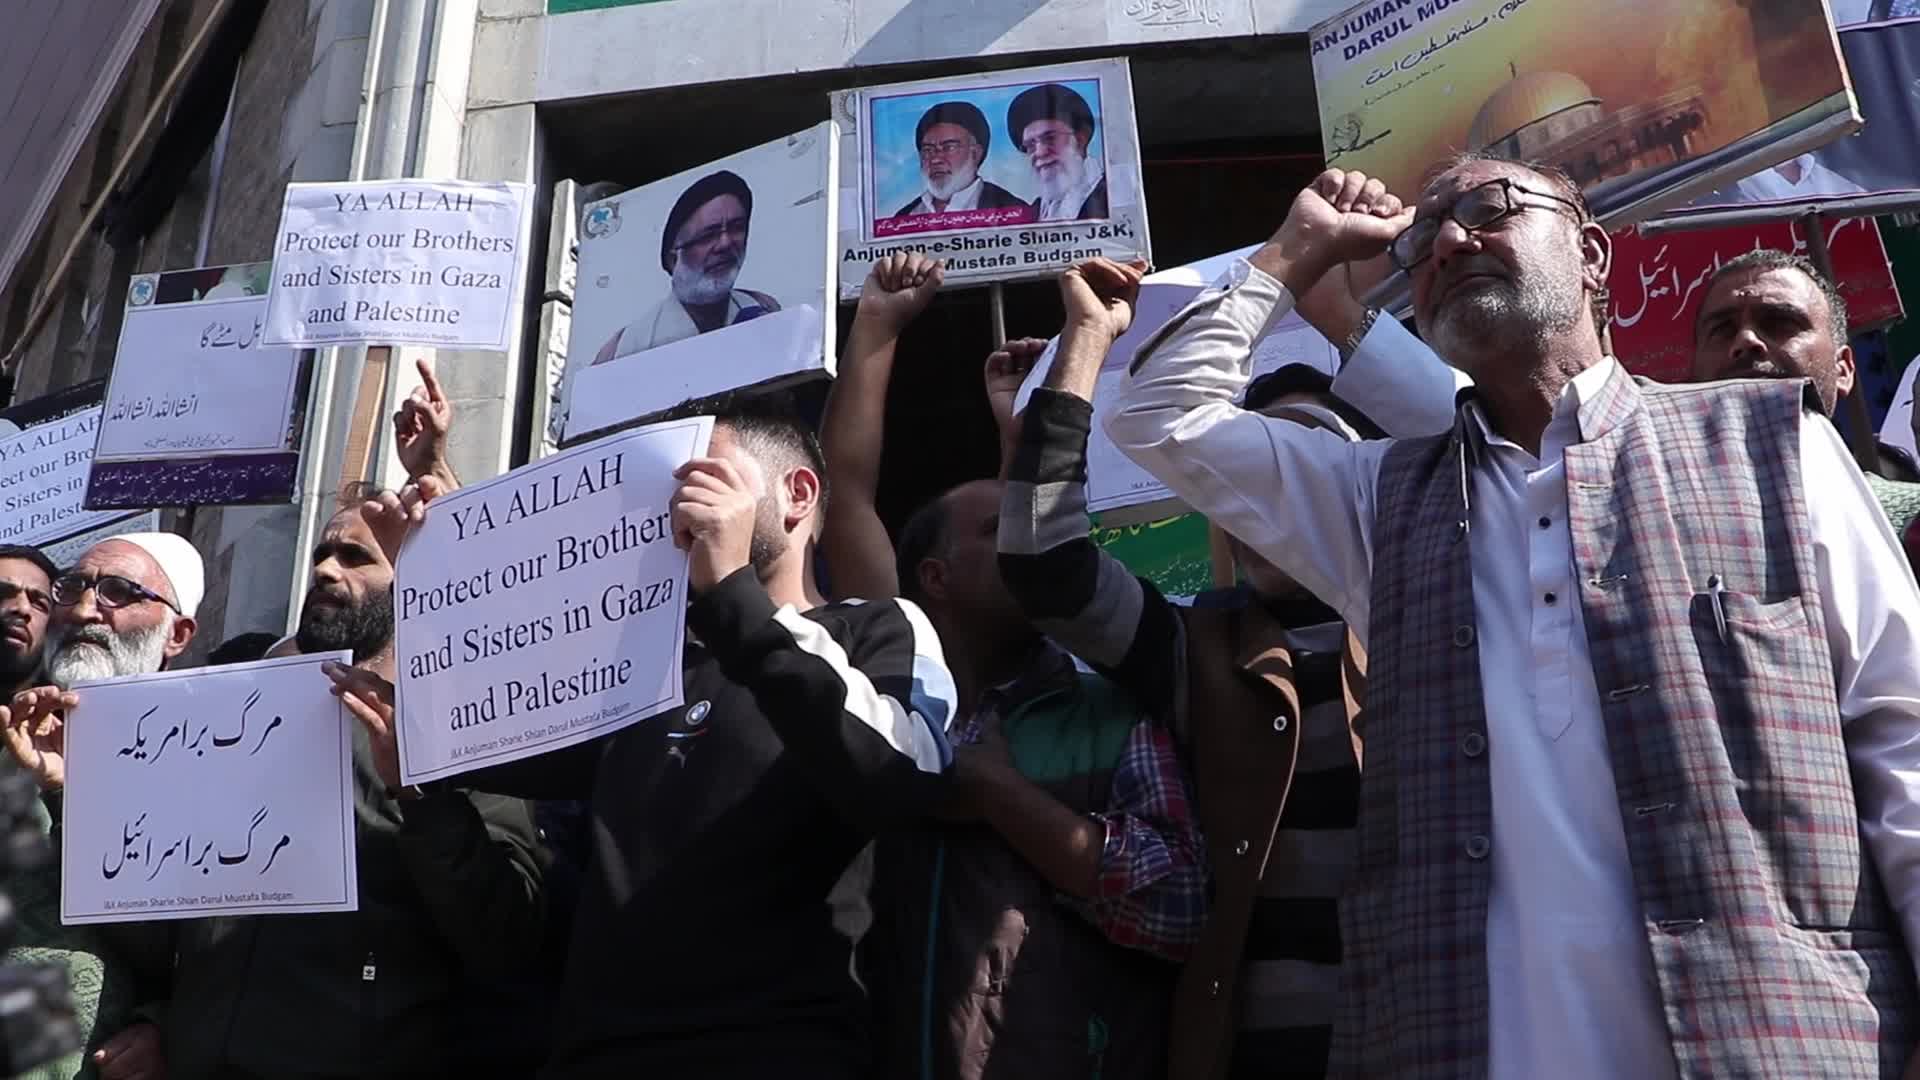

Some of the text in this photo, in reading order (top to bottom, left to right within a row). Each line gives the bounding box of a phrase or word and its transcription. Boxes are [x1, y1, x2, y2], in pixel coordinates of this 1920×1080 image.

[1343, 17, 1413, 61] DARUL
[334, 192, 473, 212] YA ALLAH
[284, 228, 513, 253] Protect our Brothers
[843, 233, 1012, 262] Anjuman-e-Sharie
[1086, 223, 1134, 240] J&K,
[1024, 246, 1103, 264] Budgam
[281, 264, 501, 288] and Sisters in Gaza
[308, 301, 460, 325] and Palestine
[0, 439, 25, 462] YA
[30, 460, 58, 478] our
[64, 447, 95, 467] Bro
[5, 476, 83, 513] Sisters in
[452, 452, 624, 542] YA ALLAH
[30, 503, 82, 529] Palest
[400, 513, 669, 620] Protect our Brother
[410, 578, 674, 679] and Sisters in Gaza
[450, 657, 632, 731] and Palestine
[213, 688, 282, 756] مرگ
[217, 805, 291, 875] مرگ
